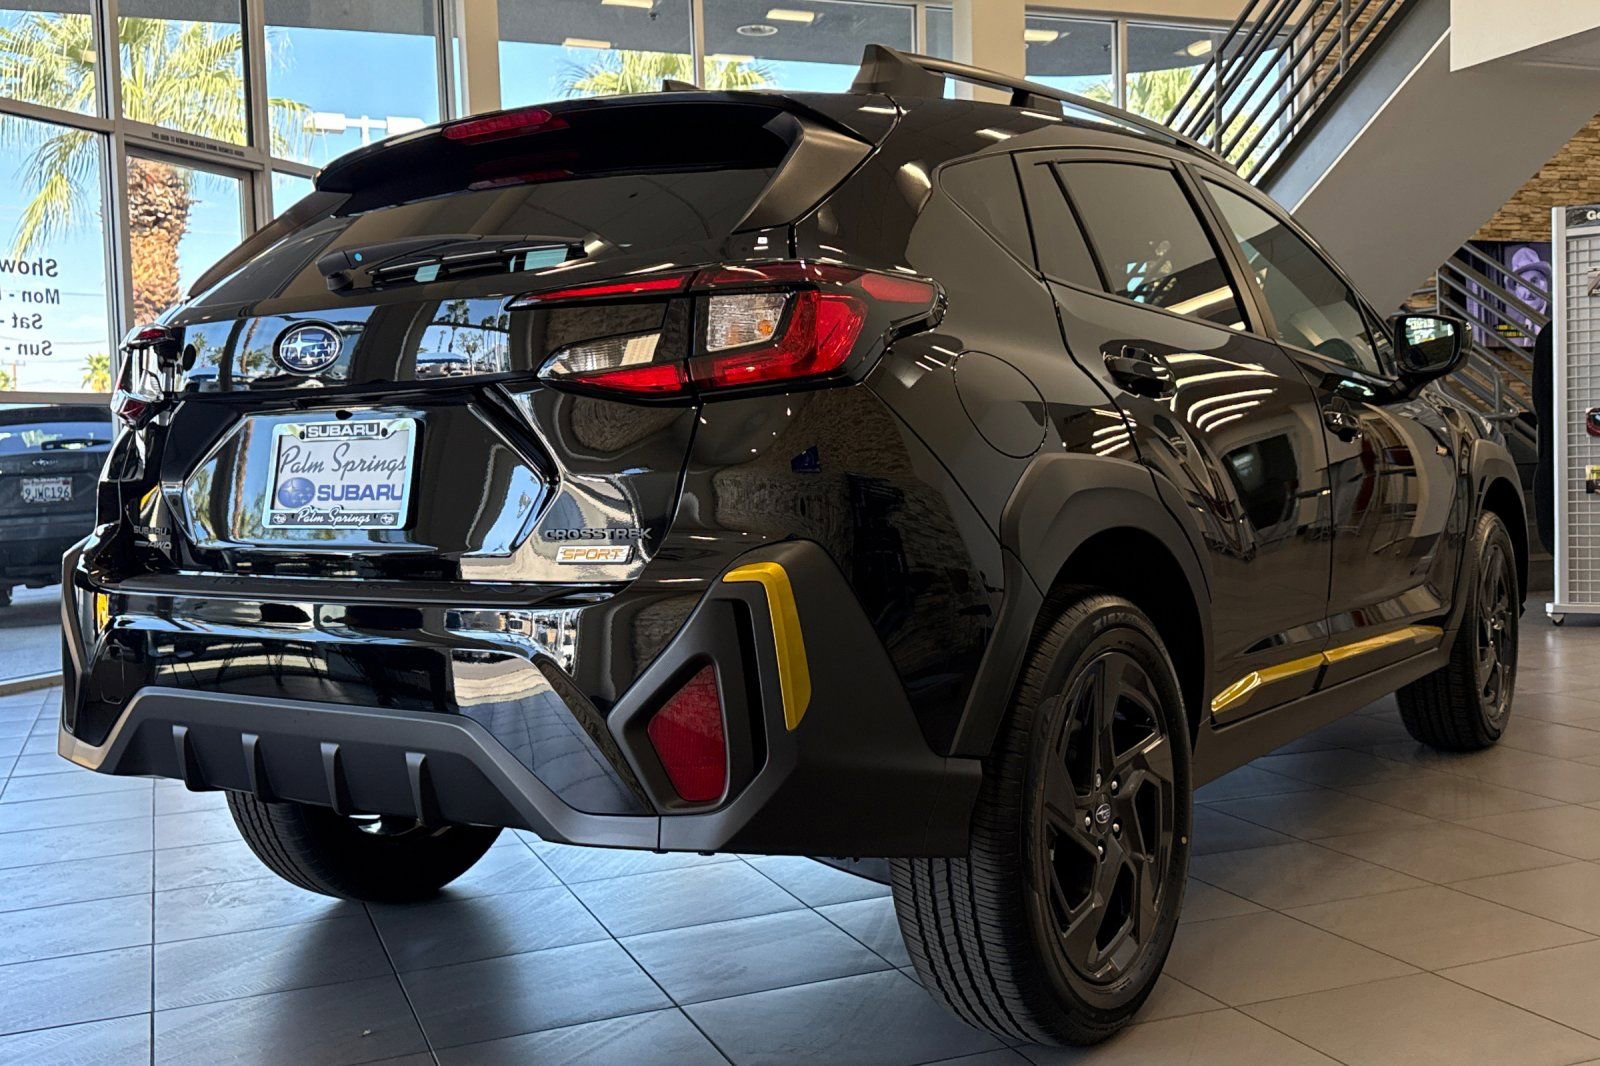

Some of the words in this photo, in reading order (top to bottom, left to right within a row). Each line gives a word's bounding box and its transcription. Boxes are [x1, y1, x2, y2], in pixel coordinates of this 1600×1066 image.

[307, 424, 378, 438] SUBARU
[280, 445, 325, 474] Palm
[331, 442, 407, 481] Springs
[317, 483, 404, 502] SUBARU
[297, 506, 325, 523] Palm
[328, 507, 371, 527] Springs
[133, 525, 167, 536] SUBARU
[544, 527, 653, 541] CROSSTREK
[148, 541, 172, 550] AWD
[562, 548, 624, 561] SPORT
